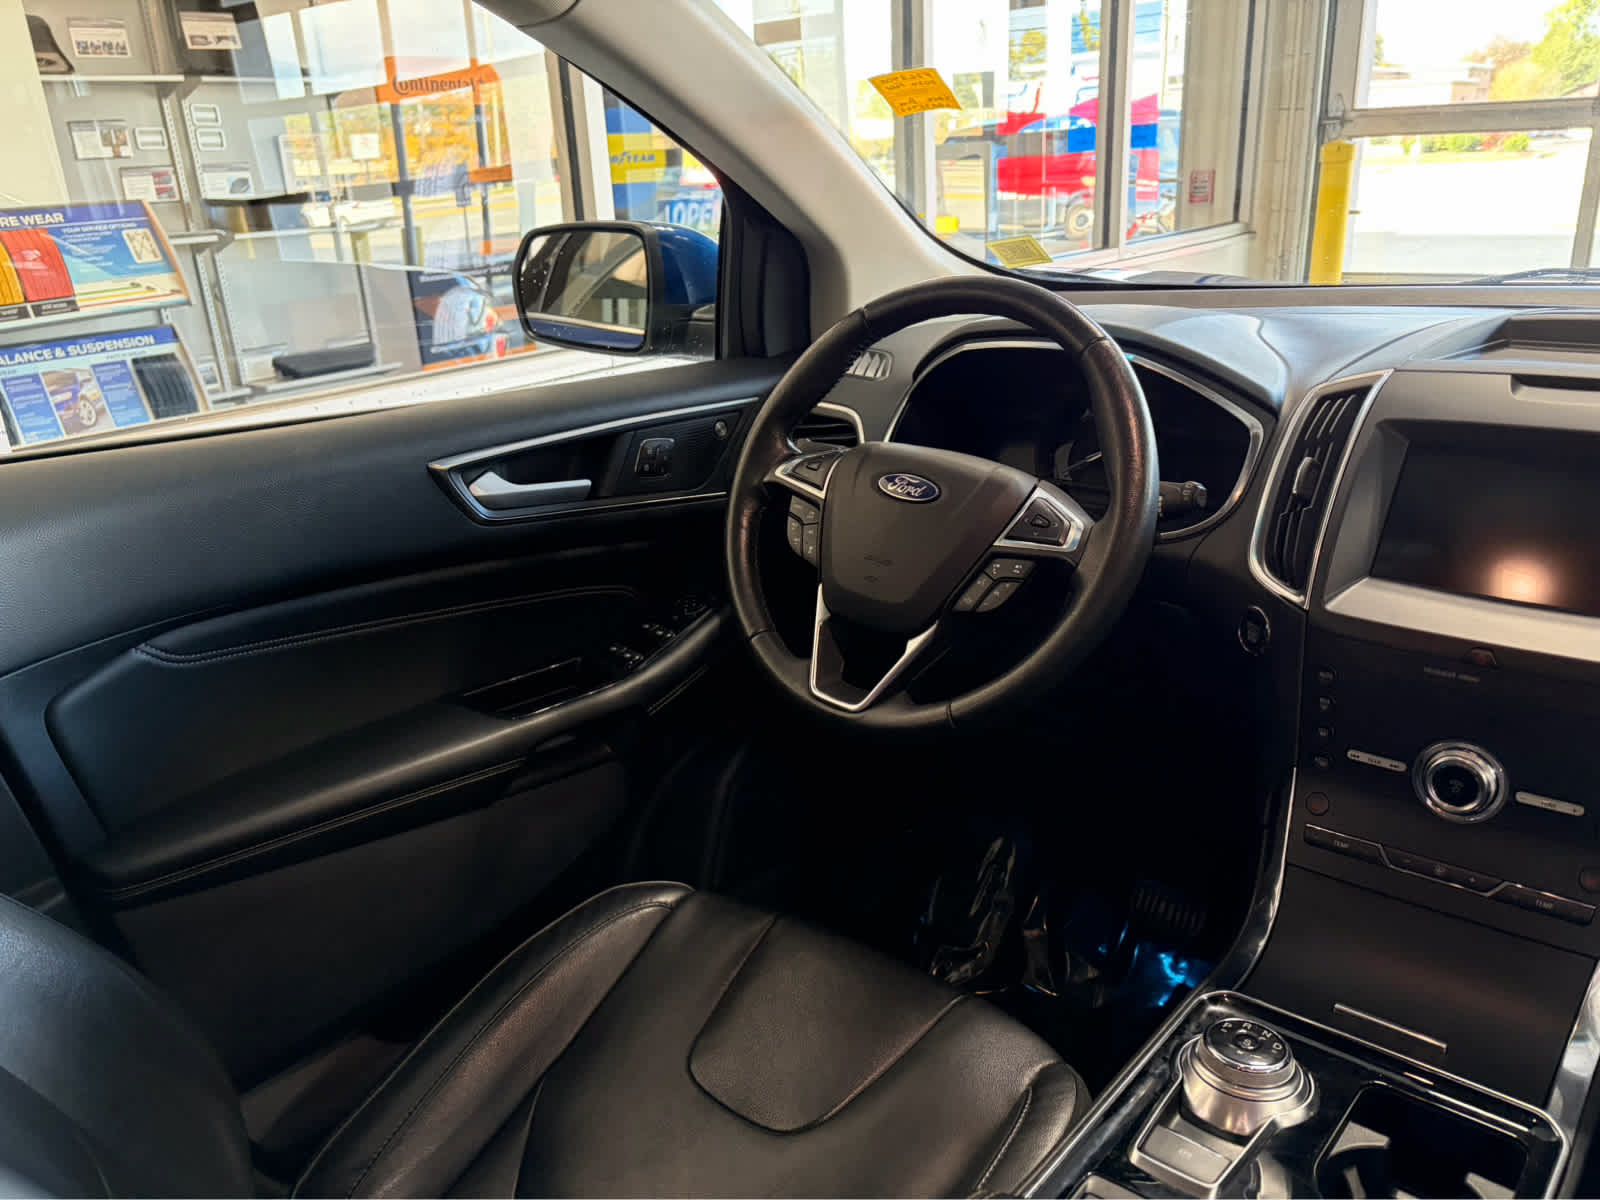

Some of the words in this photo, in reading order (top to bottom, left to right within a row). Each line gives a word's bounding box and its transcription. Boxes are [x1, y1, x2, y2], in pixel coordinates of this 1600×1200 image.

[392, 76, 476, 96] Continental
[0, 216, 20, 228] RE
[19, 212, 65, 226] WEAR
[55, 346, 66, 358] &
[67, 334, 156, 356] SUSPENSION
[887, 475, 928, 497] Ford
